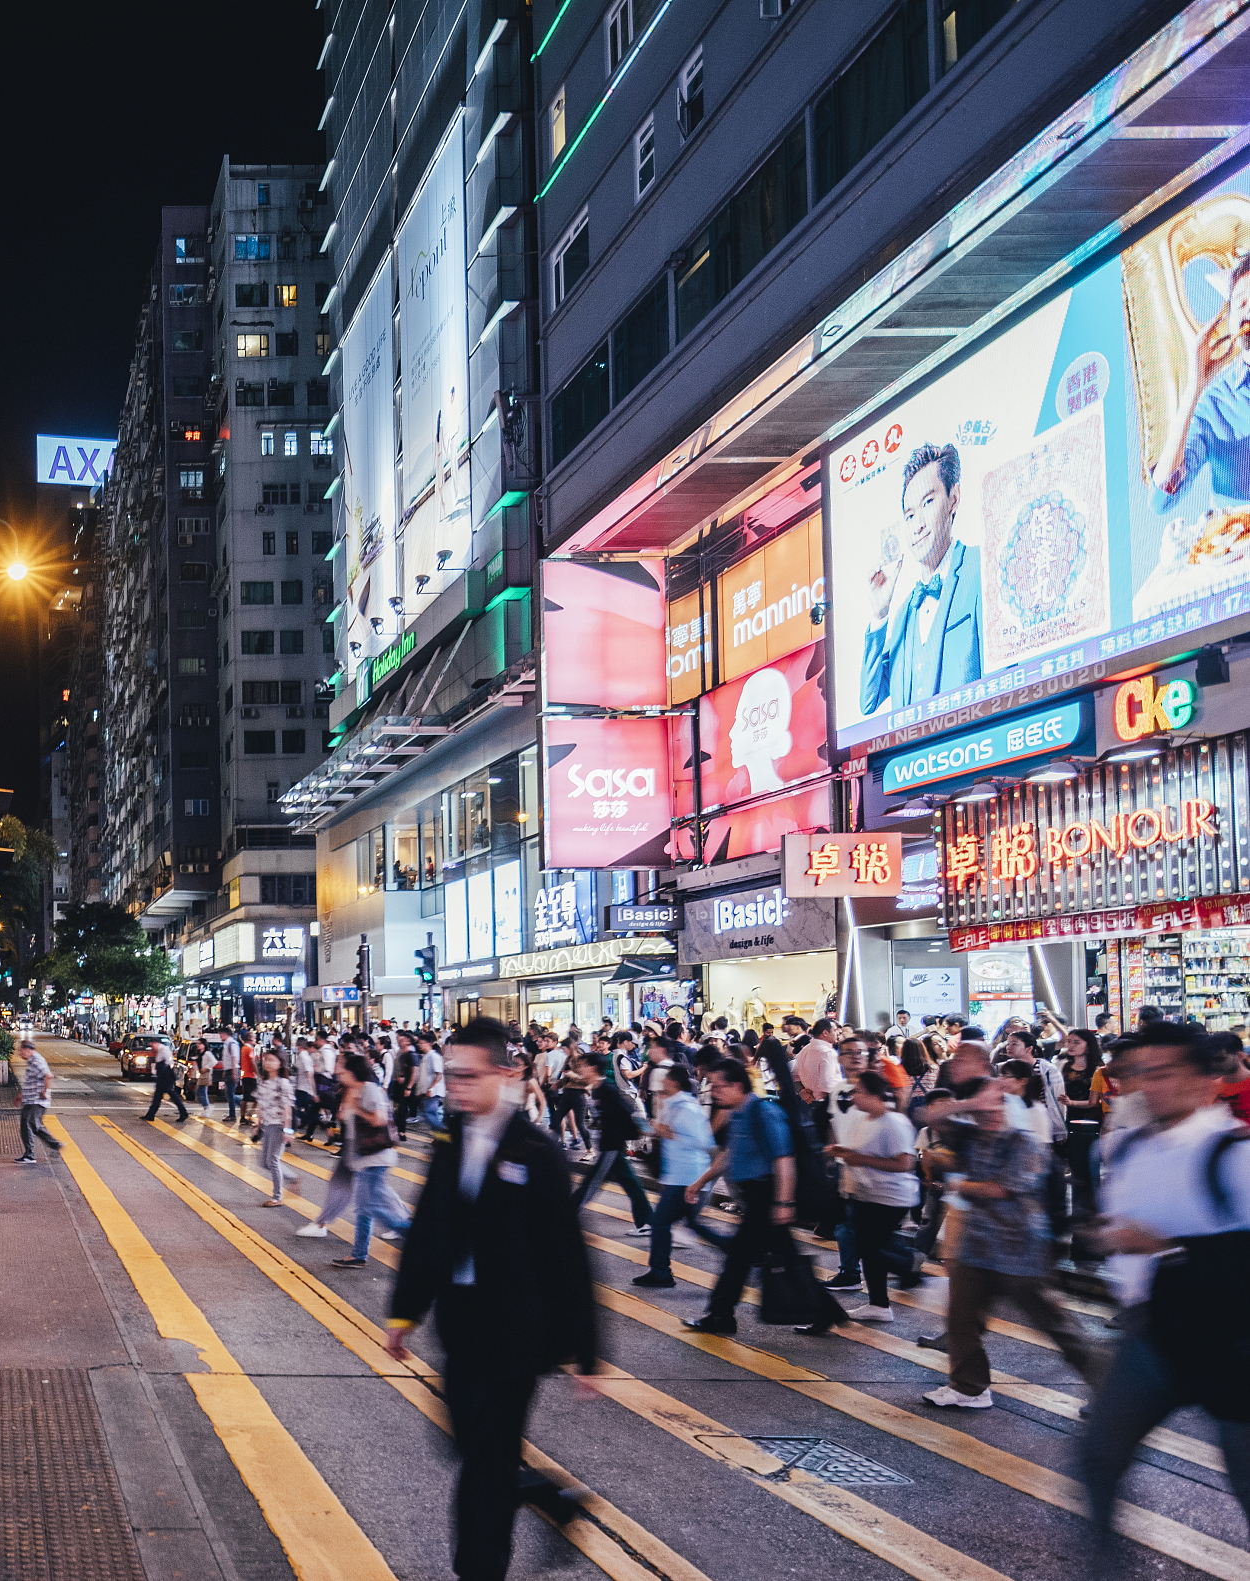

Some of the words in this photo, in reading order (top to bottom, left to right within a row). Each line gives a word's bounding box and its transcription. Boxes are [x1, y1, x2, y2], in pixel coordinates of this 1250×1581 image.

[1066, 361, 1098, 394] 香港
[732, 580, 762, 619] 萬寧
[372, 644, 402, 685] Holiday
[401, 631, 415, 659] Inn
[866, 735, 890, 755] JM
[895, 705, 984, 745] NETWORK
[990, 663, 1107, 716] 27230020
[893, 736, 994, 783] watsons
[1006, 716, 1063, 754] 屈臣氏
[843, 758, 866, 773] JM
[592, 800, 629, 819] 莎莎
[572, 823, 599, 836] making
[599, 822, 615, 836] life
[615, 822, 649, 836] beautiful
[1045, 798, 1216, 863] BONJOUR
[1151, 908, 1193, 929] SALE
[262, 927, 303, 949] 六福
[957, 931, 987, 949] SALE
[990, 921, 1042, 939] 即時立減
[729, 937, 753, 949] design
[754, 936, 760, 946] &
[760, 934, 774, 946] life
[243, 976, 286, 988] RADO
[912, 974, 928, 982] NIKE
